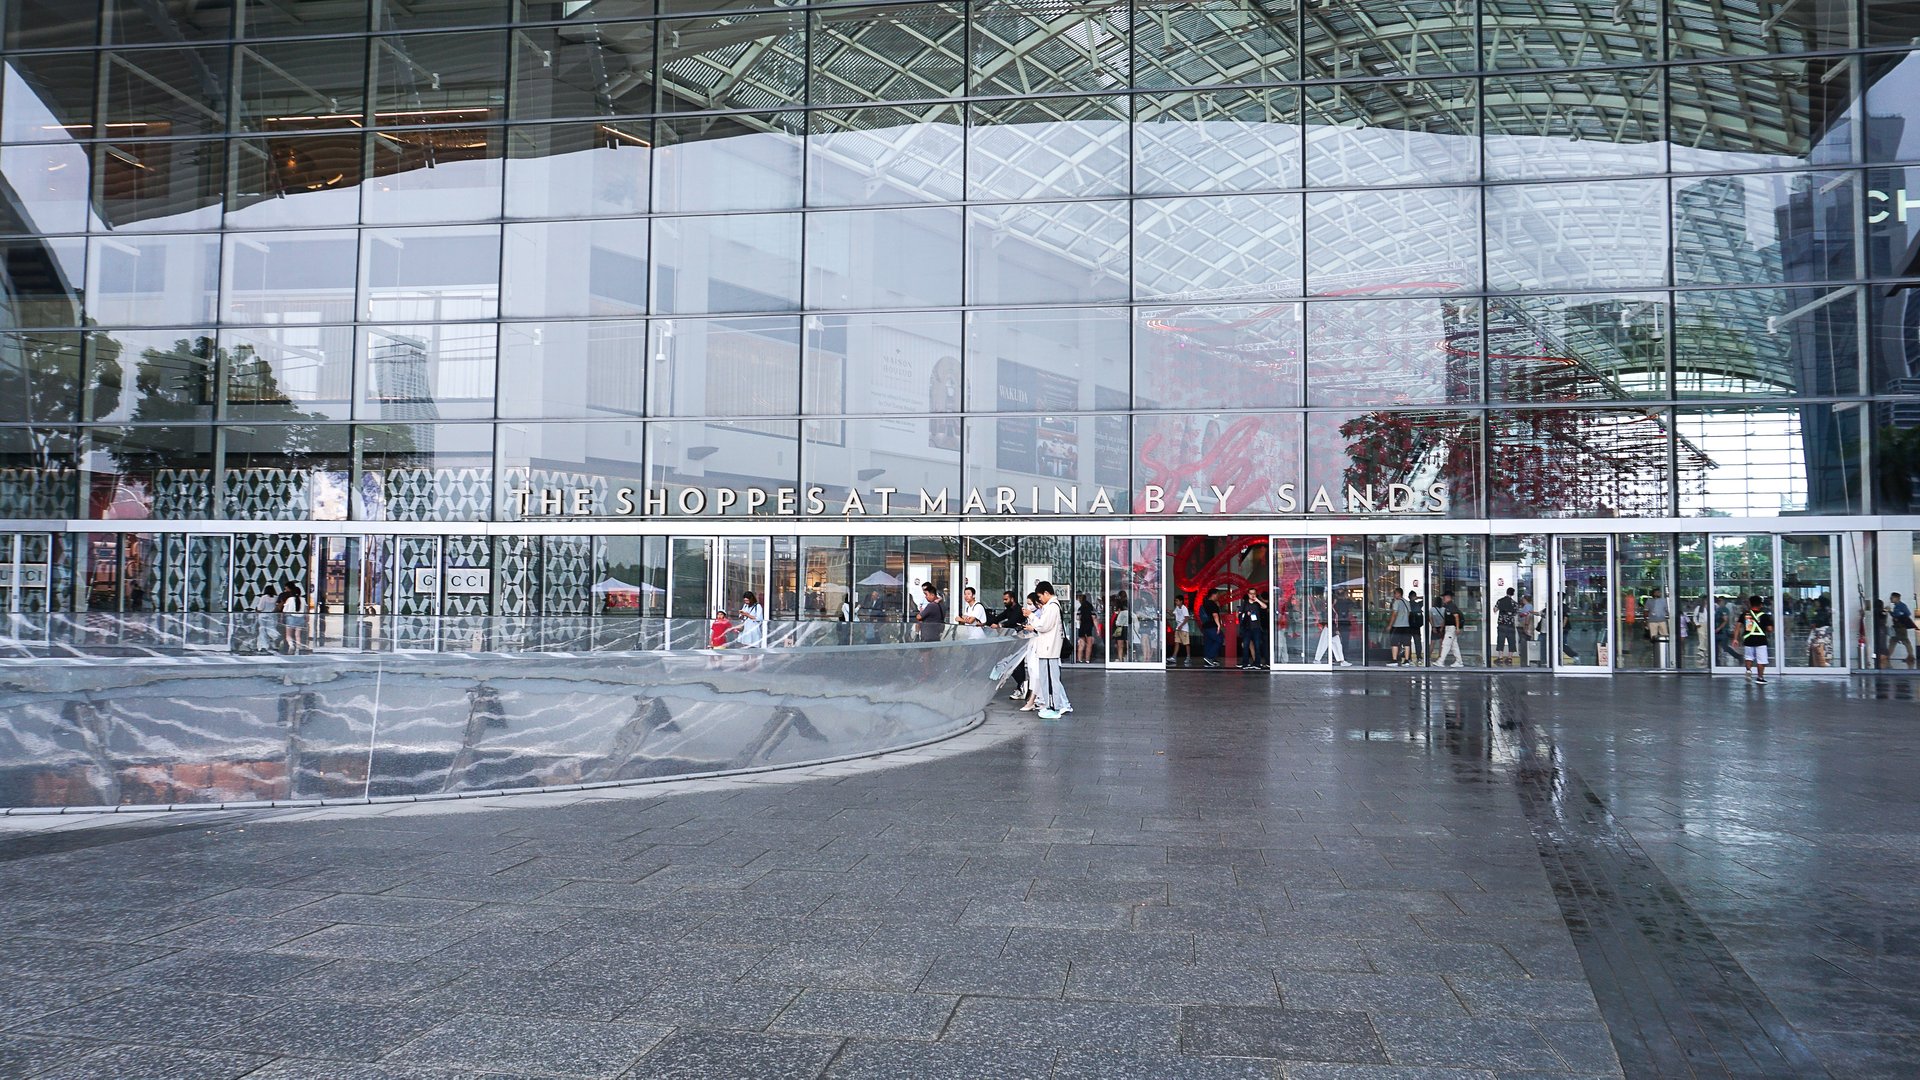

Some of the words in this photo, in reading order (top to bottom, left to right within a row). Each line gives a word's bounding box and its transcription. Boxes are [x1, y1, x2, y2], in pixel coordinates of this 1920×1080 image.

[999, 384, 1028, 404] WAKUDA
[512, 488, 592, 515] THE
[616, 487, 825, 515] SHOPPES
[841, 488, 897, 515] AT
[920, 486, 1115, 515] MARINA
[1145, 485, 1236, 514] BAY
[1277, 483, 1446, 513] SANDS
[0, 570, 43, 581] UCI
[423, 575, 484, 587] GCCI
